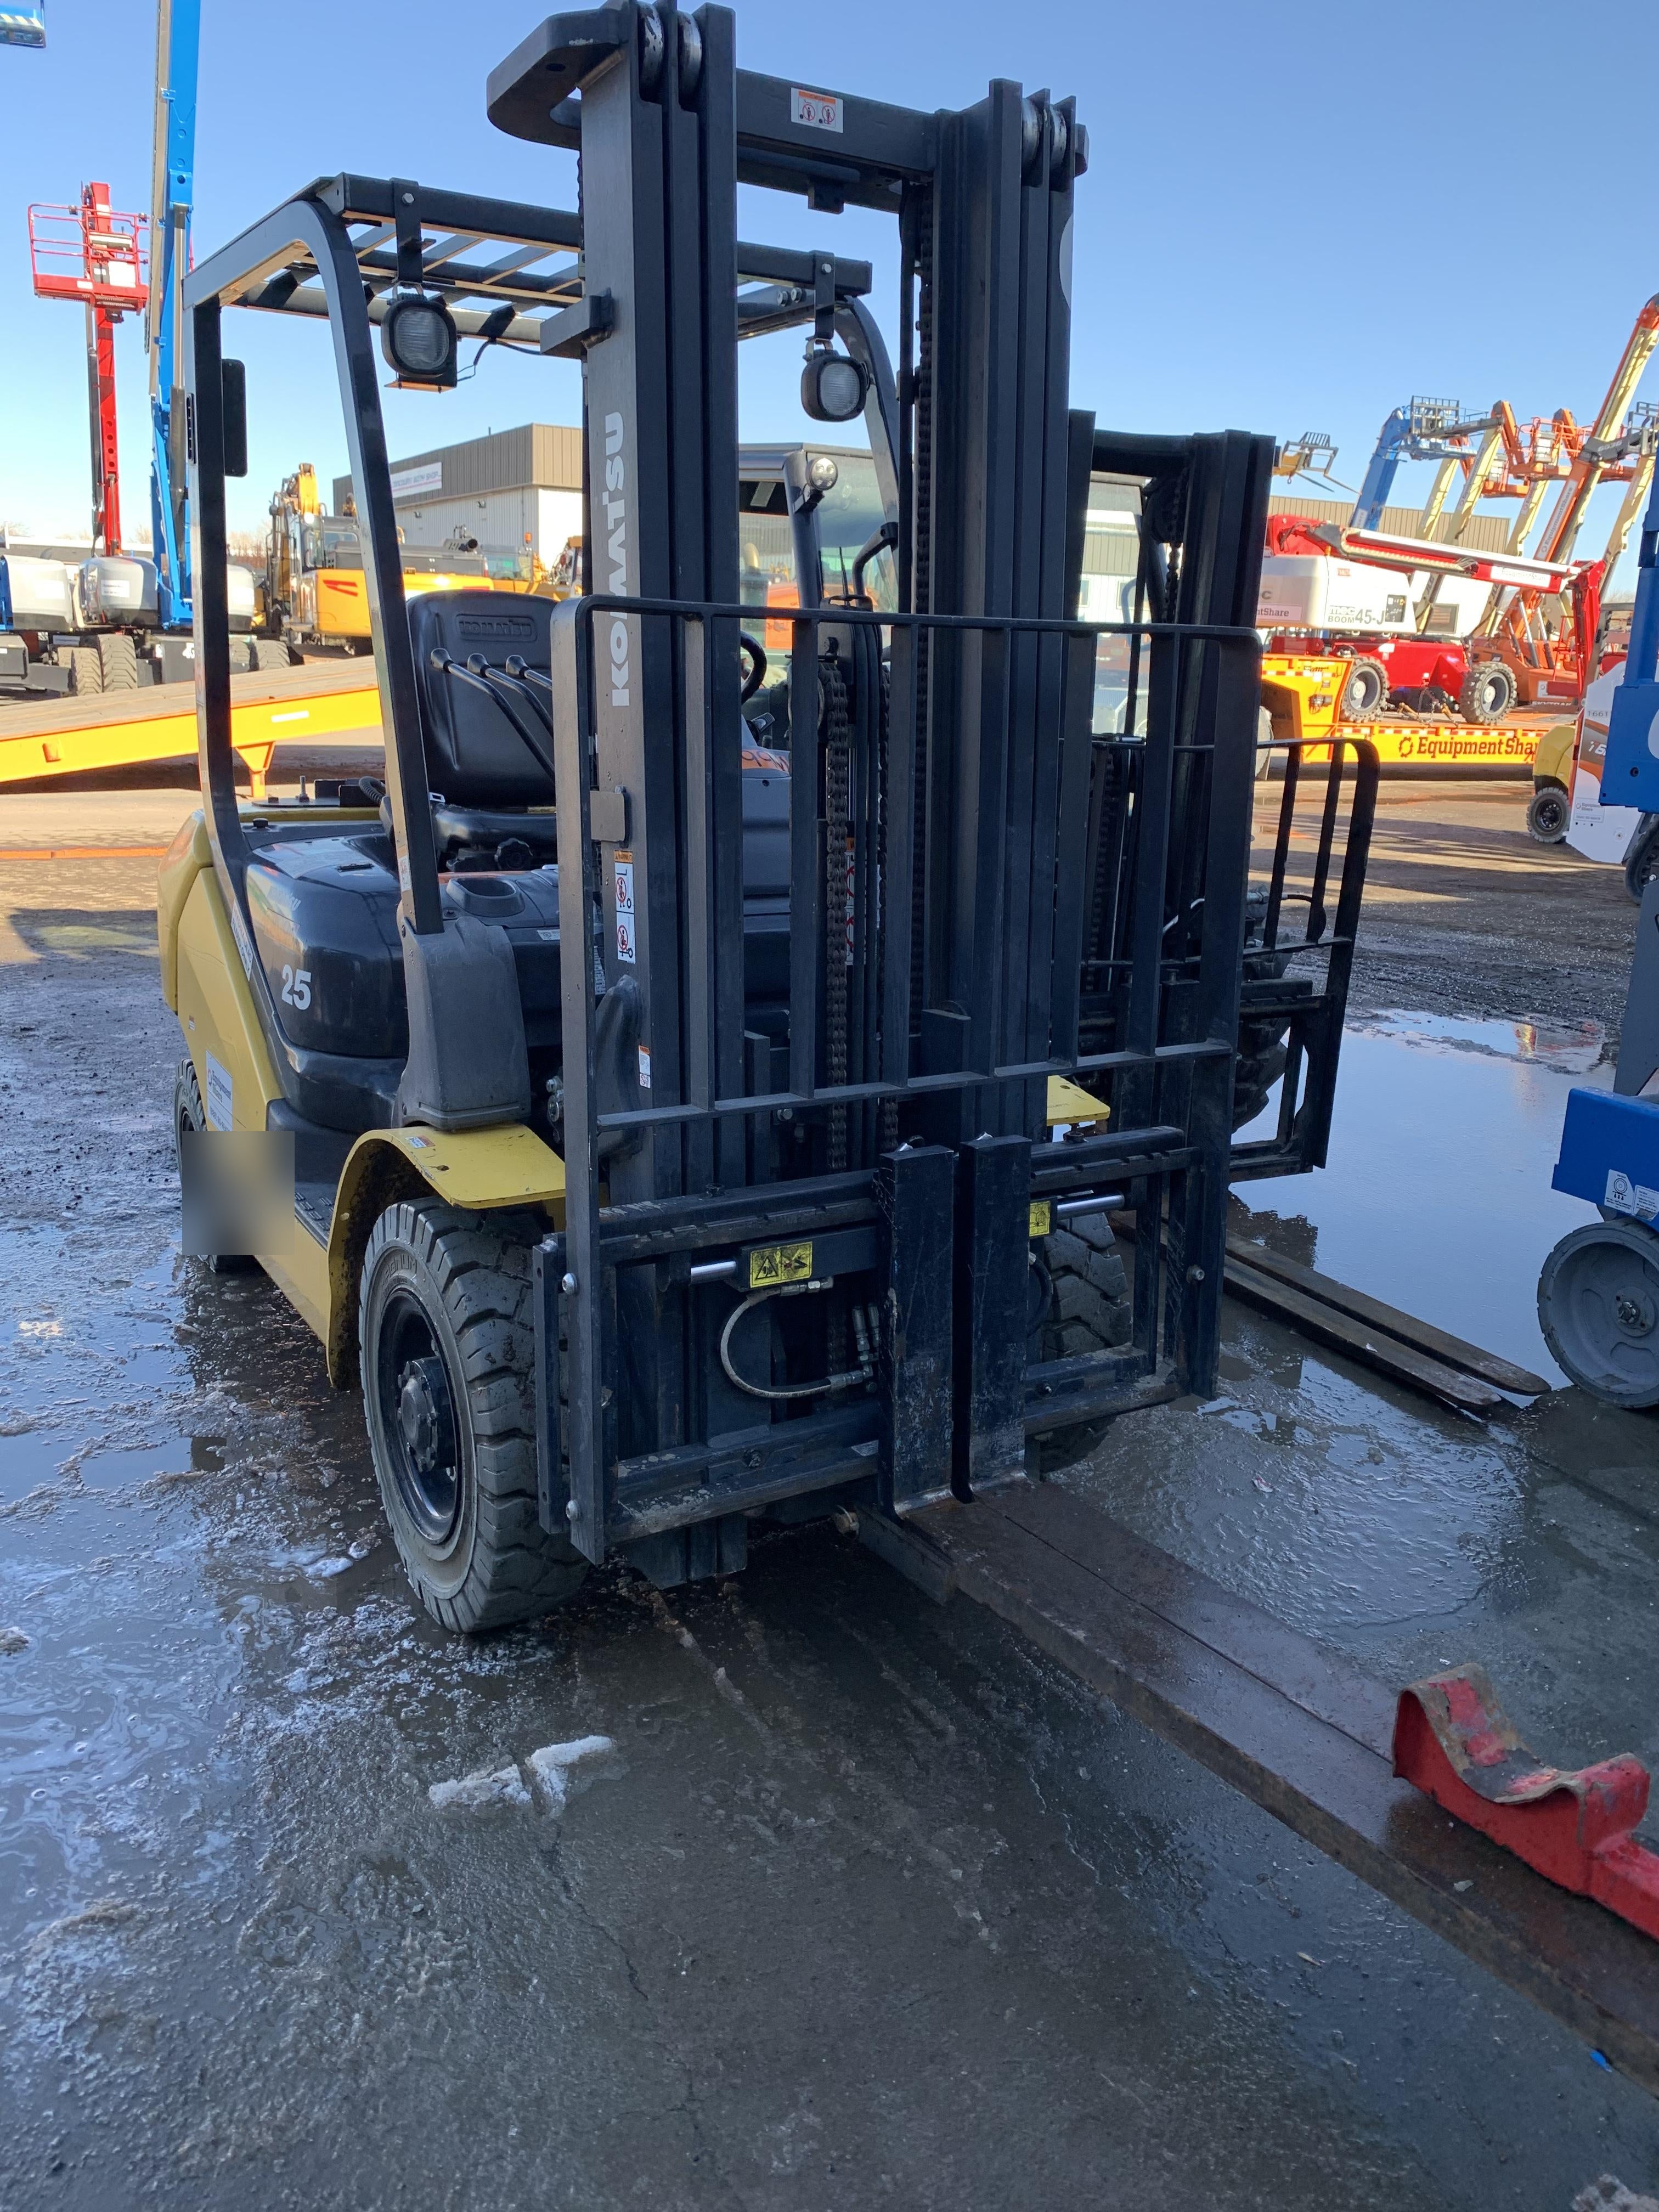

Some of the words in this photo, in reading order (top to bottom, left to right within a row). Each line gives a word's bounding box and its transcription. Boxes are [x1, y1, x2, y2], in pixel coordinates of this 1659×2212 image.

[602, 411, 630, 707] KOMATSU
[459, 619, 532, 636] KOMATSU
[1328, 615, 1354, 623] BOOM
[1355, 608, 1385, 625] 45-J
[1417, 736, 1537, 759] EquipmentSha
[281, 964, 312, 1010] 25
